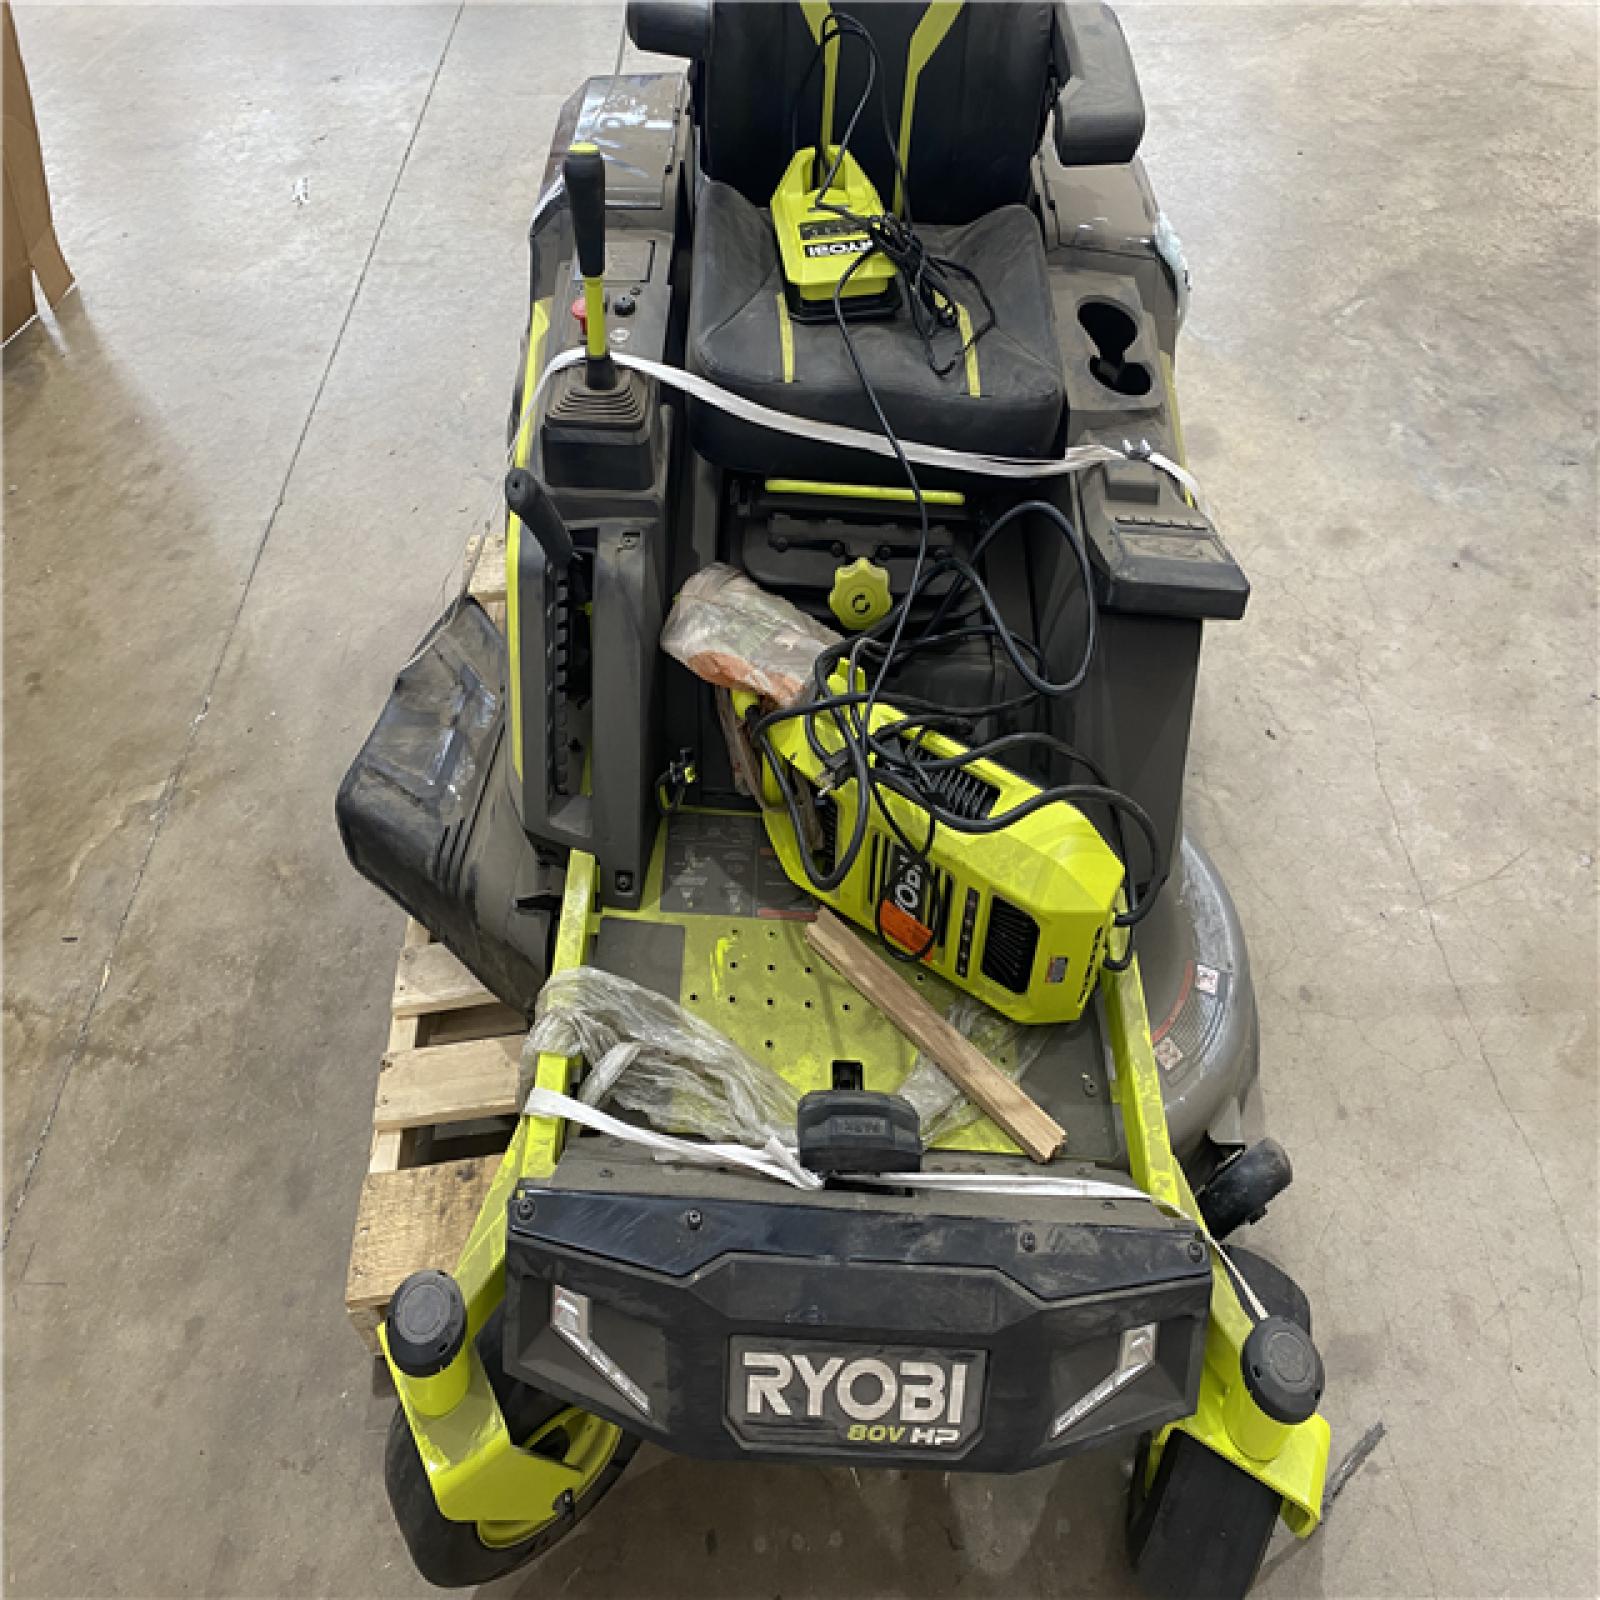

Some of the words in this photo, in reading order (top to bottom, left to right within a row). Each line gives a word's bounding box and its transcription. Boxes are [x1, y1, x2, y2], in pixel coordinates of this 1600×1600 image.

[743, 1351, 969, 1424] RYOBI
[847, 1424, 906, 1443] 80V
[909, 1426, 961, 1446] HP
